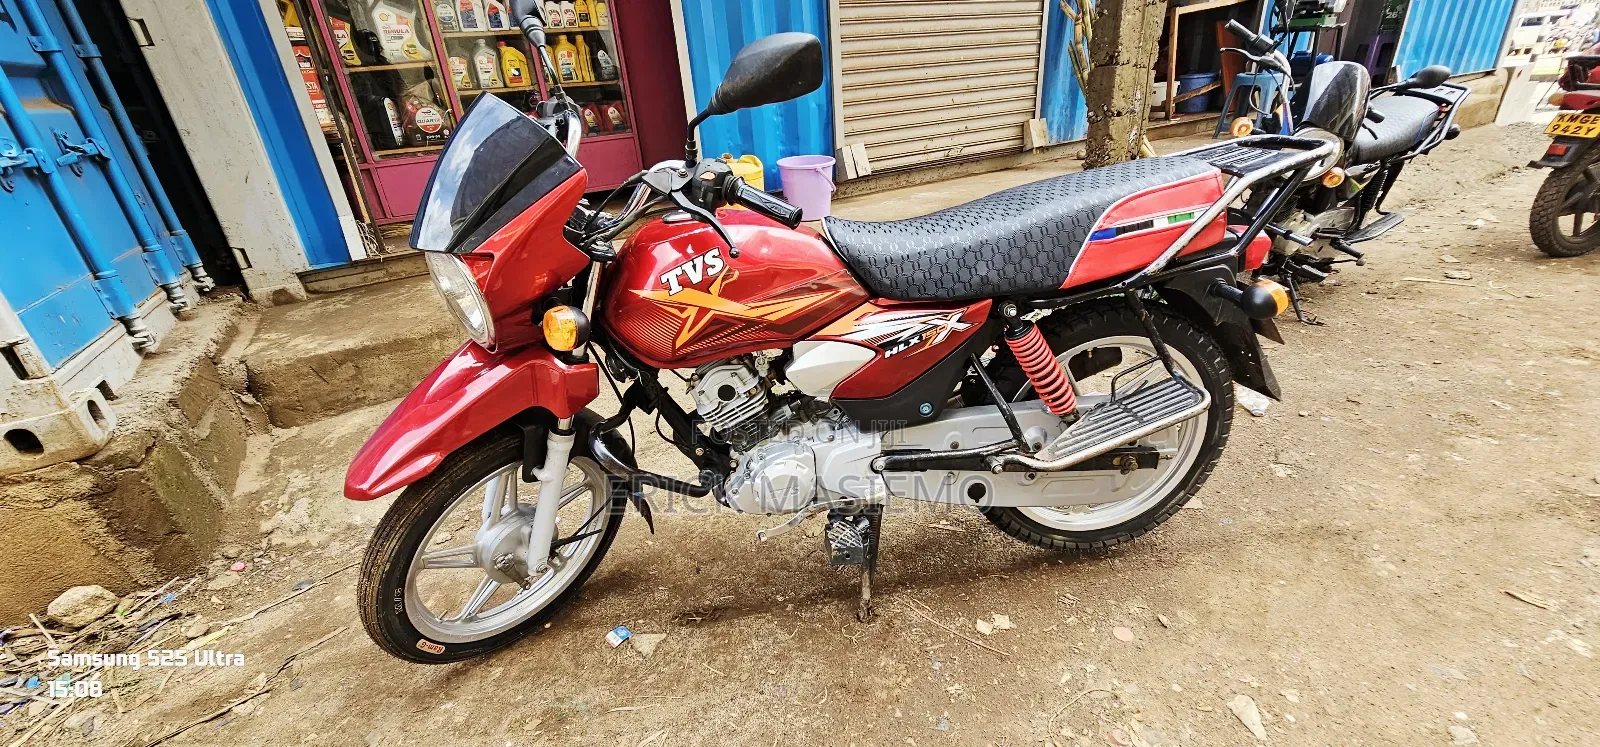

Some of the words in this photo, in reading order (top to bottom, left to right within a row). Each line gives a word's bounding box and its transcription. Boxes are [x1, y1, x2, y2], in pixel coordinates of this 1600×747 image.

[1557, 113, 1600, 125] KMGE
[1551, 123, 1597, 136] 942Y
[660, 247, 725, 296] TVS
[884, 335, 921, 359] HLX
